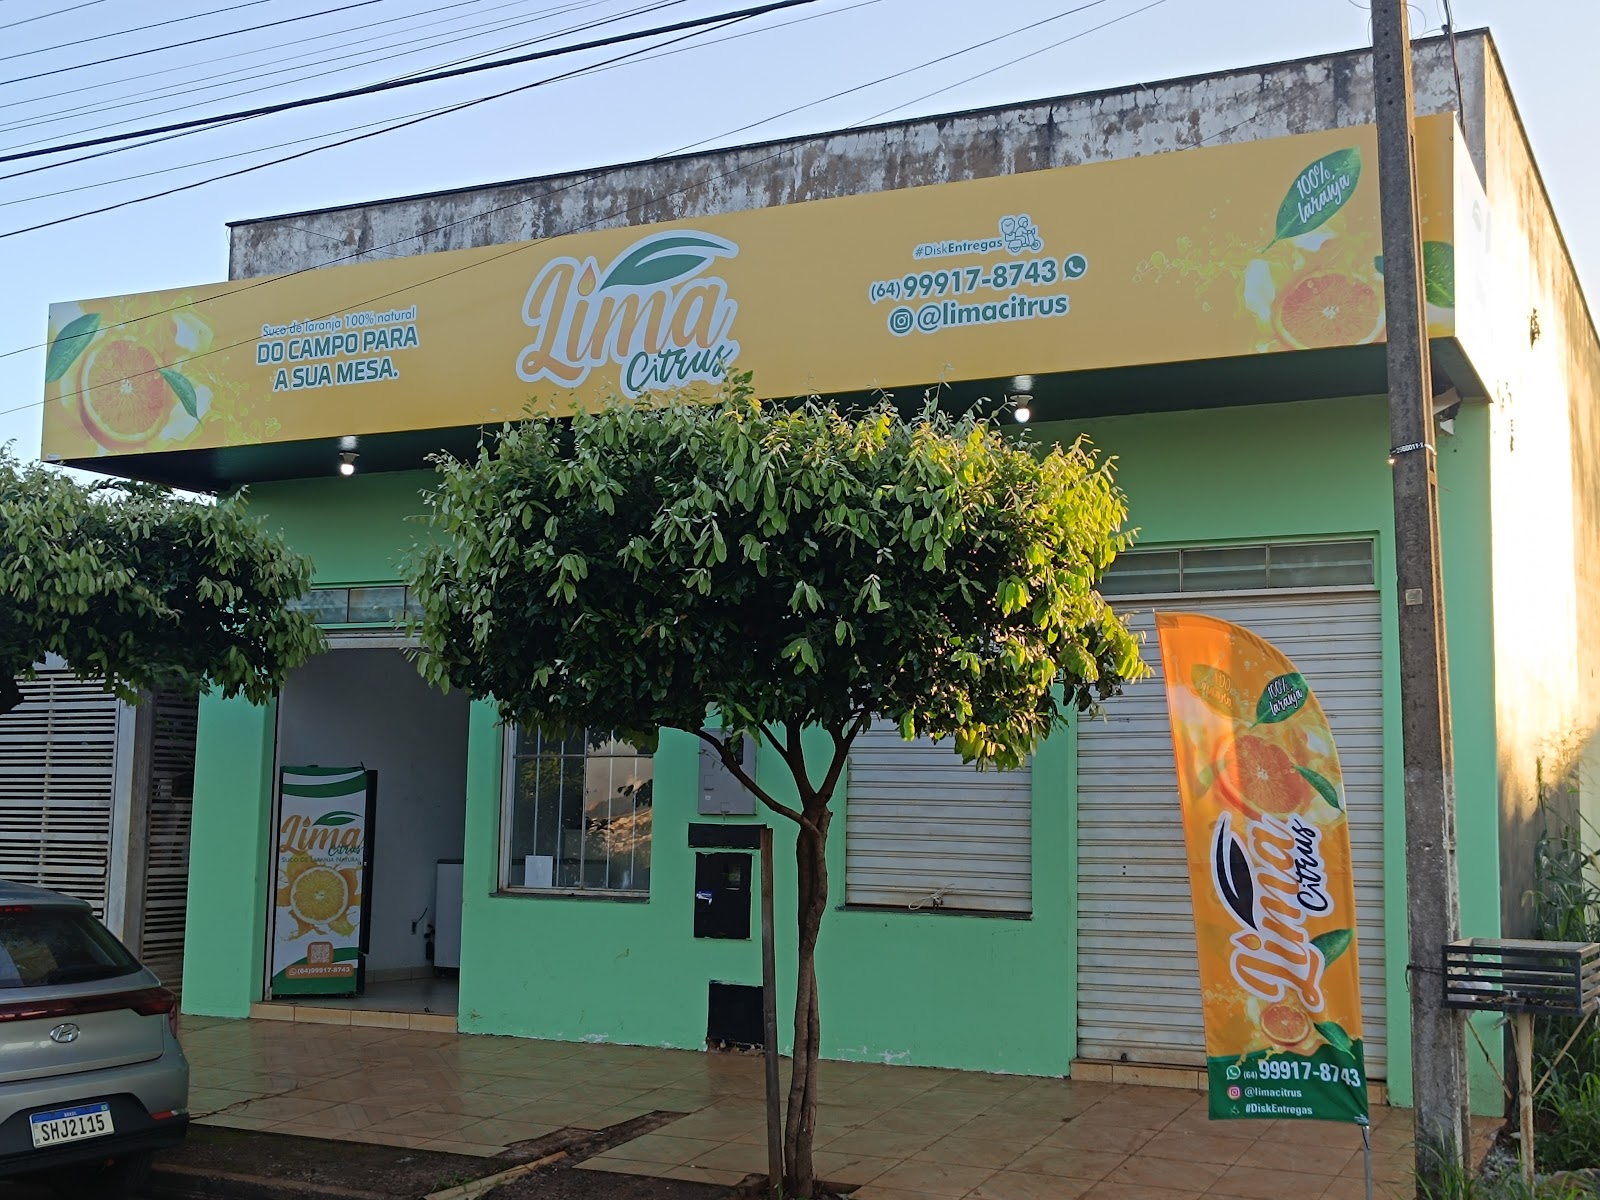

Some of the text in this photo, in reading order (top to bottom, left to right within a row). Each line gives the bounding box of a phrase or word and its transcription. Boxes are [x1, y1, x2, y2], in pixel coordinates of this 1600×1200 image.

[1297, 162, 1331, 199] 100%
[1297, 174, 1350, 223] laranja
[915, 238, 1003, 257] #DiskEntregas
[262, 307, 416, 337] Suco de laranja 100% natural
[522, 262, 732, 381] Lima
[917, 295, 1068, 331] @limacitrus
[257, 326, 418, 364] DO CAMPO PARA
[274, 358, 398, 390] A SUA MESA.
[626, 345, 733, 392] Citrus
[1268, 677, 1290, 697] 100%
[1268, 687, 1304, 716] laranja
[279, 814, 362, 856] Lima
[1292, 818, 1329, 912] Citrus
[1236, 818, 1320, 1007] Lima
[1244, 1087, 1302, 1098] @limacitrus
[1245, 1103, 1313, 1116] #DiskEntregas
[41, 1114, 105, 1141] SHJ2I15
